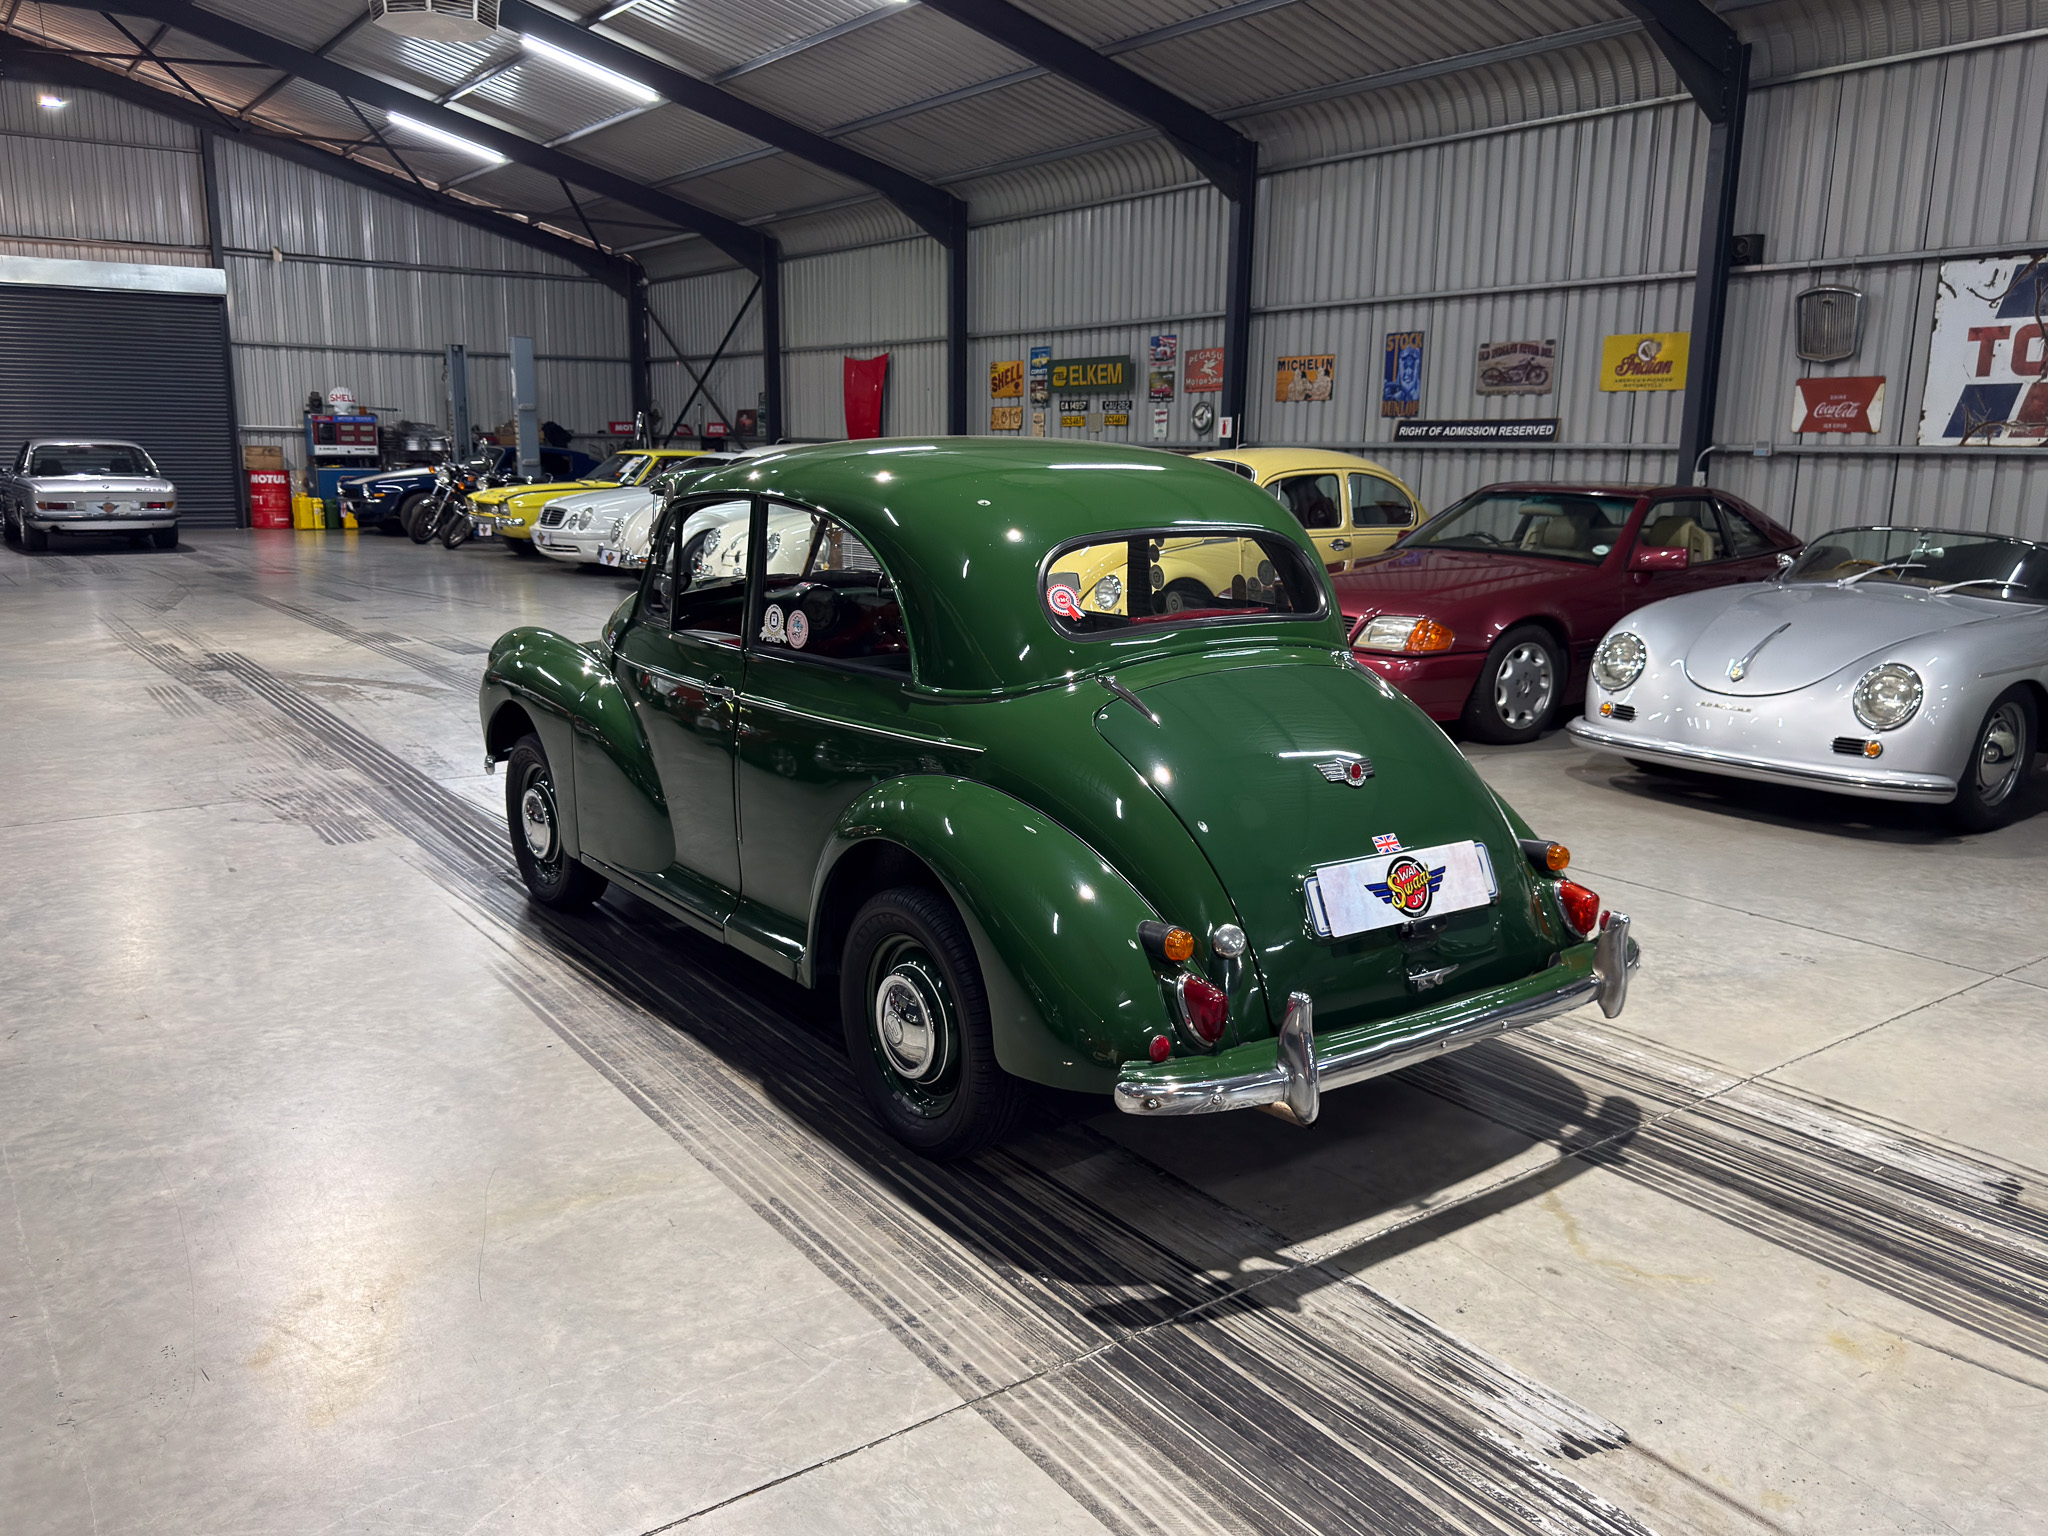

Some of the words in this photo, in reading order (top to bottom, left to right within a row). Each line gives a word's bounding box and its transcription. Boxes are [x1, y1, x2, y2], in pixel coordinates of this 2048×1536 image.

[1189, 351, 1223, 366] PEGASU
[1277, 358, 1333, 372] MICHELIN
[1615, 353, 1673, 376] Indian
[991, 363, 1023, 392] SHELL
[1069, 363, 1122, 386] ELKEM
[330, 394, 356, 403] SHELL
[1382, 401, 1419, 417] DUNLOP
[1398, 426, 1428, 436] RIGHT
[1428, 426, 1442, 436] OF
[1443, 425, 1497, 436] ADMISSION
[1498, 425, 1554, 435] RESERVED
[251, 474, 286, 484] MOTUL
[1412, 891, 1424, 906] JY
